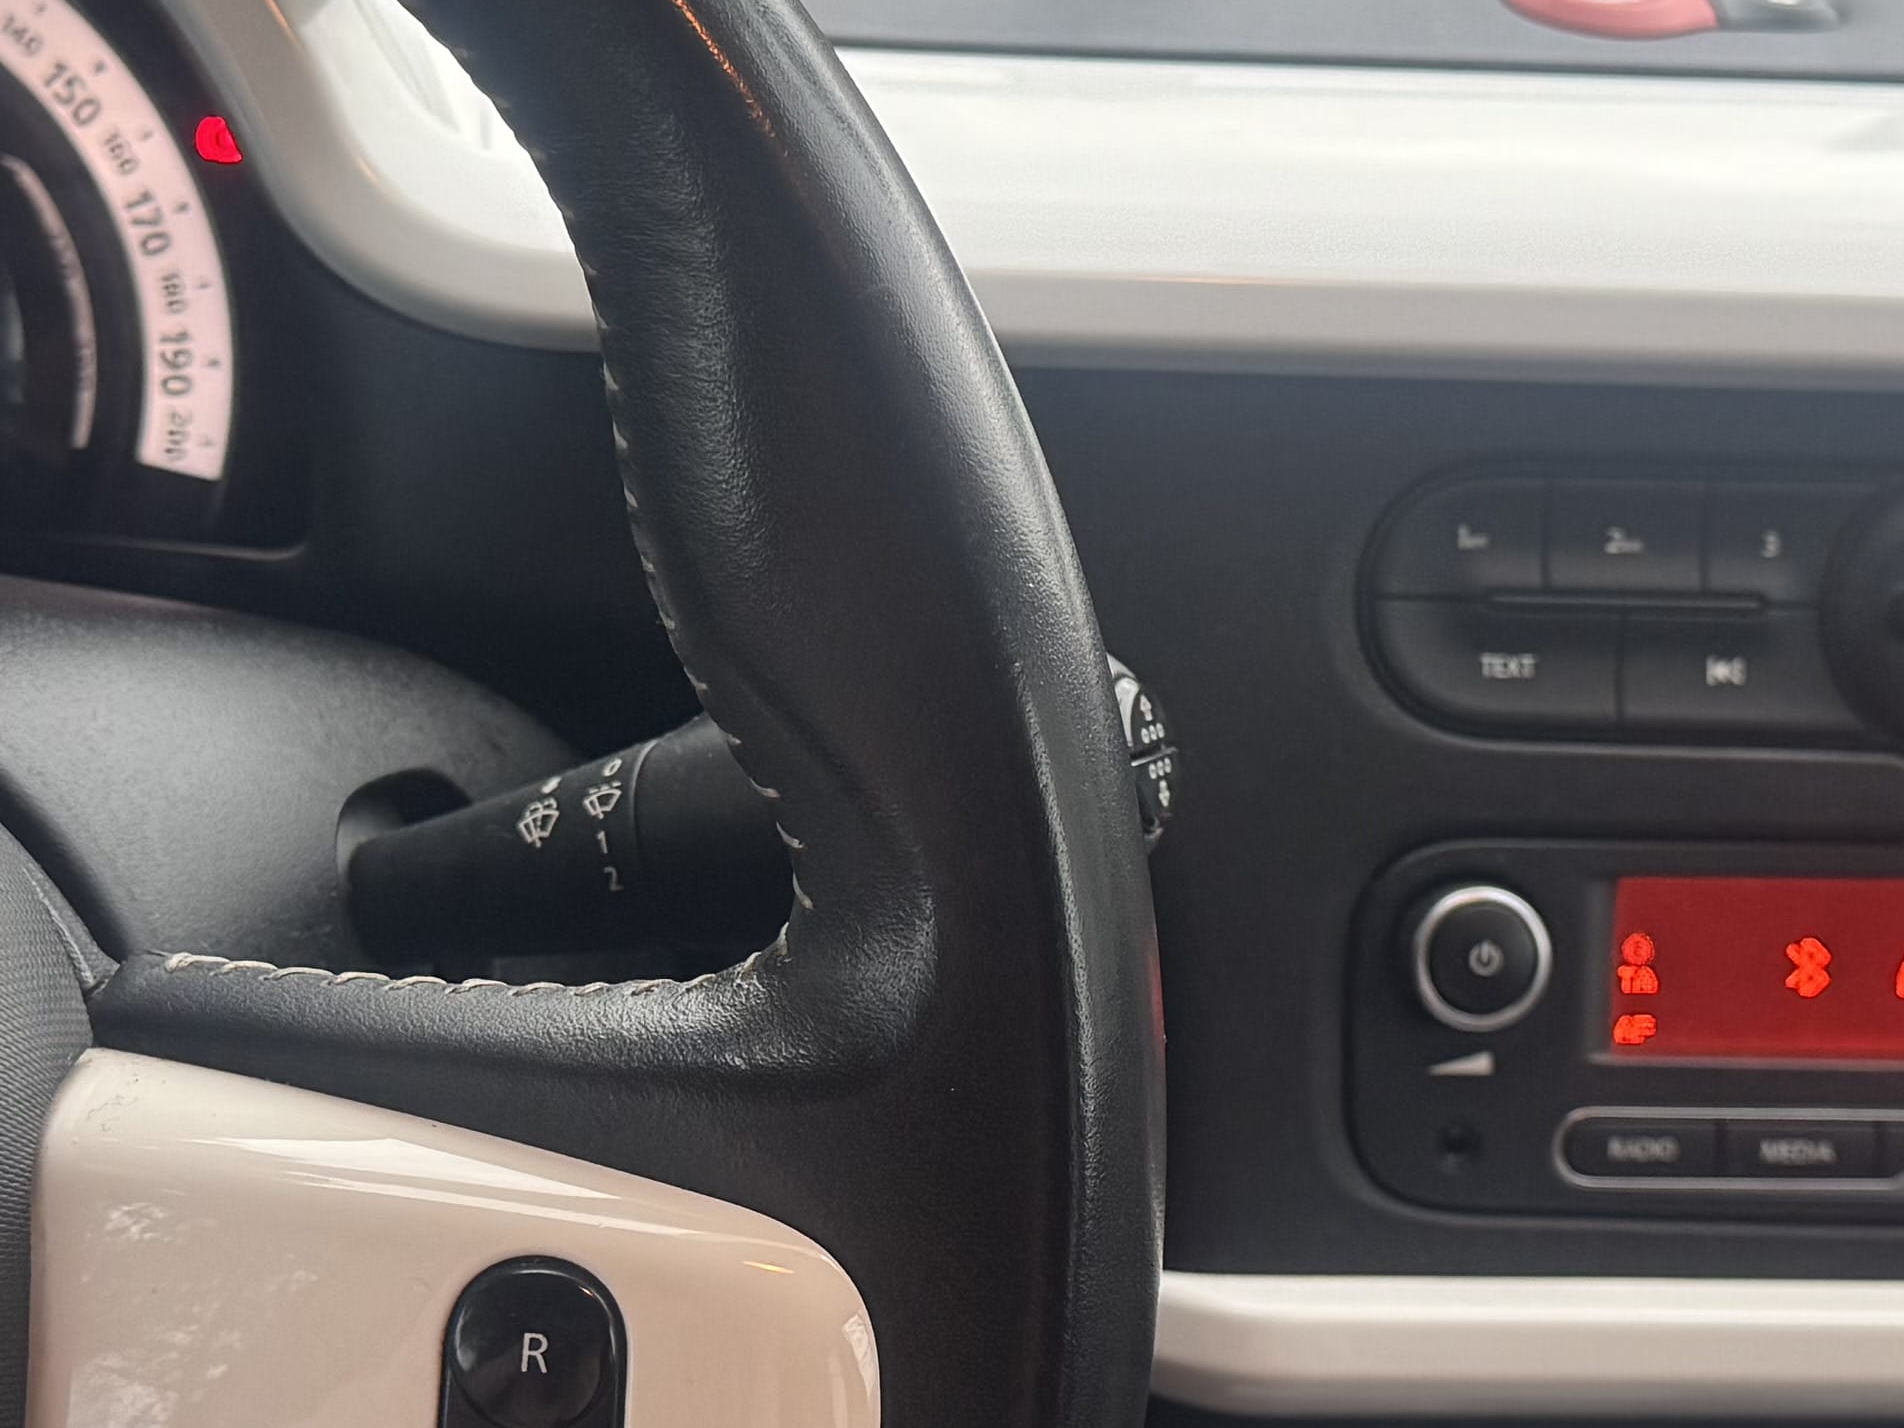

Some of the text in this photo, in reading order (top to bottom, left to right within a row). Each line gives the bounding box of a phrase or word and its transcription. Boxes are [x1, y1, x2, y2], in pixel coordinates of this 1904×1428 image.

[0, 12, 44, 57] 140
[44, 61, 101, 126] 150
[121, 187, 172, 258] 170
[158, 329, 194, 399] 190
[1762, 529, 1781, 558] 3
[1480, 651, 1536, 679] TEXT
[597, 830, 608, 854] 1
[603, 866, 624, 892] 2
[1759, 1139, 1838, 1165] MEDIA
[520, 1332, 549, 1374] R
